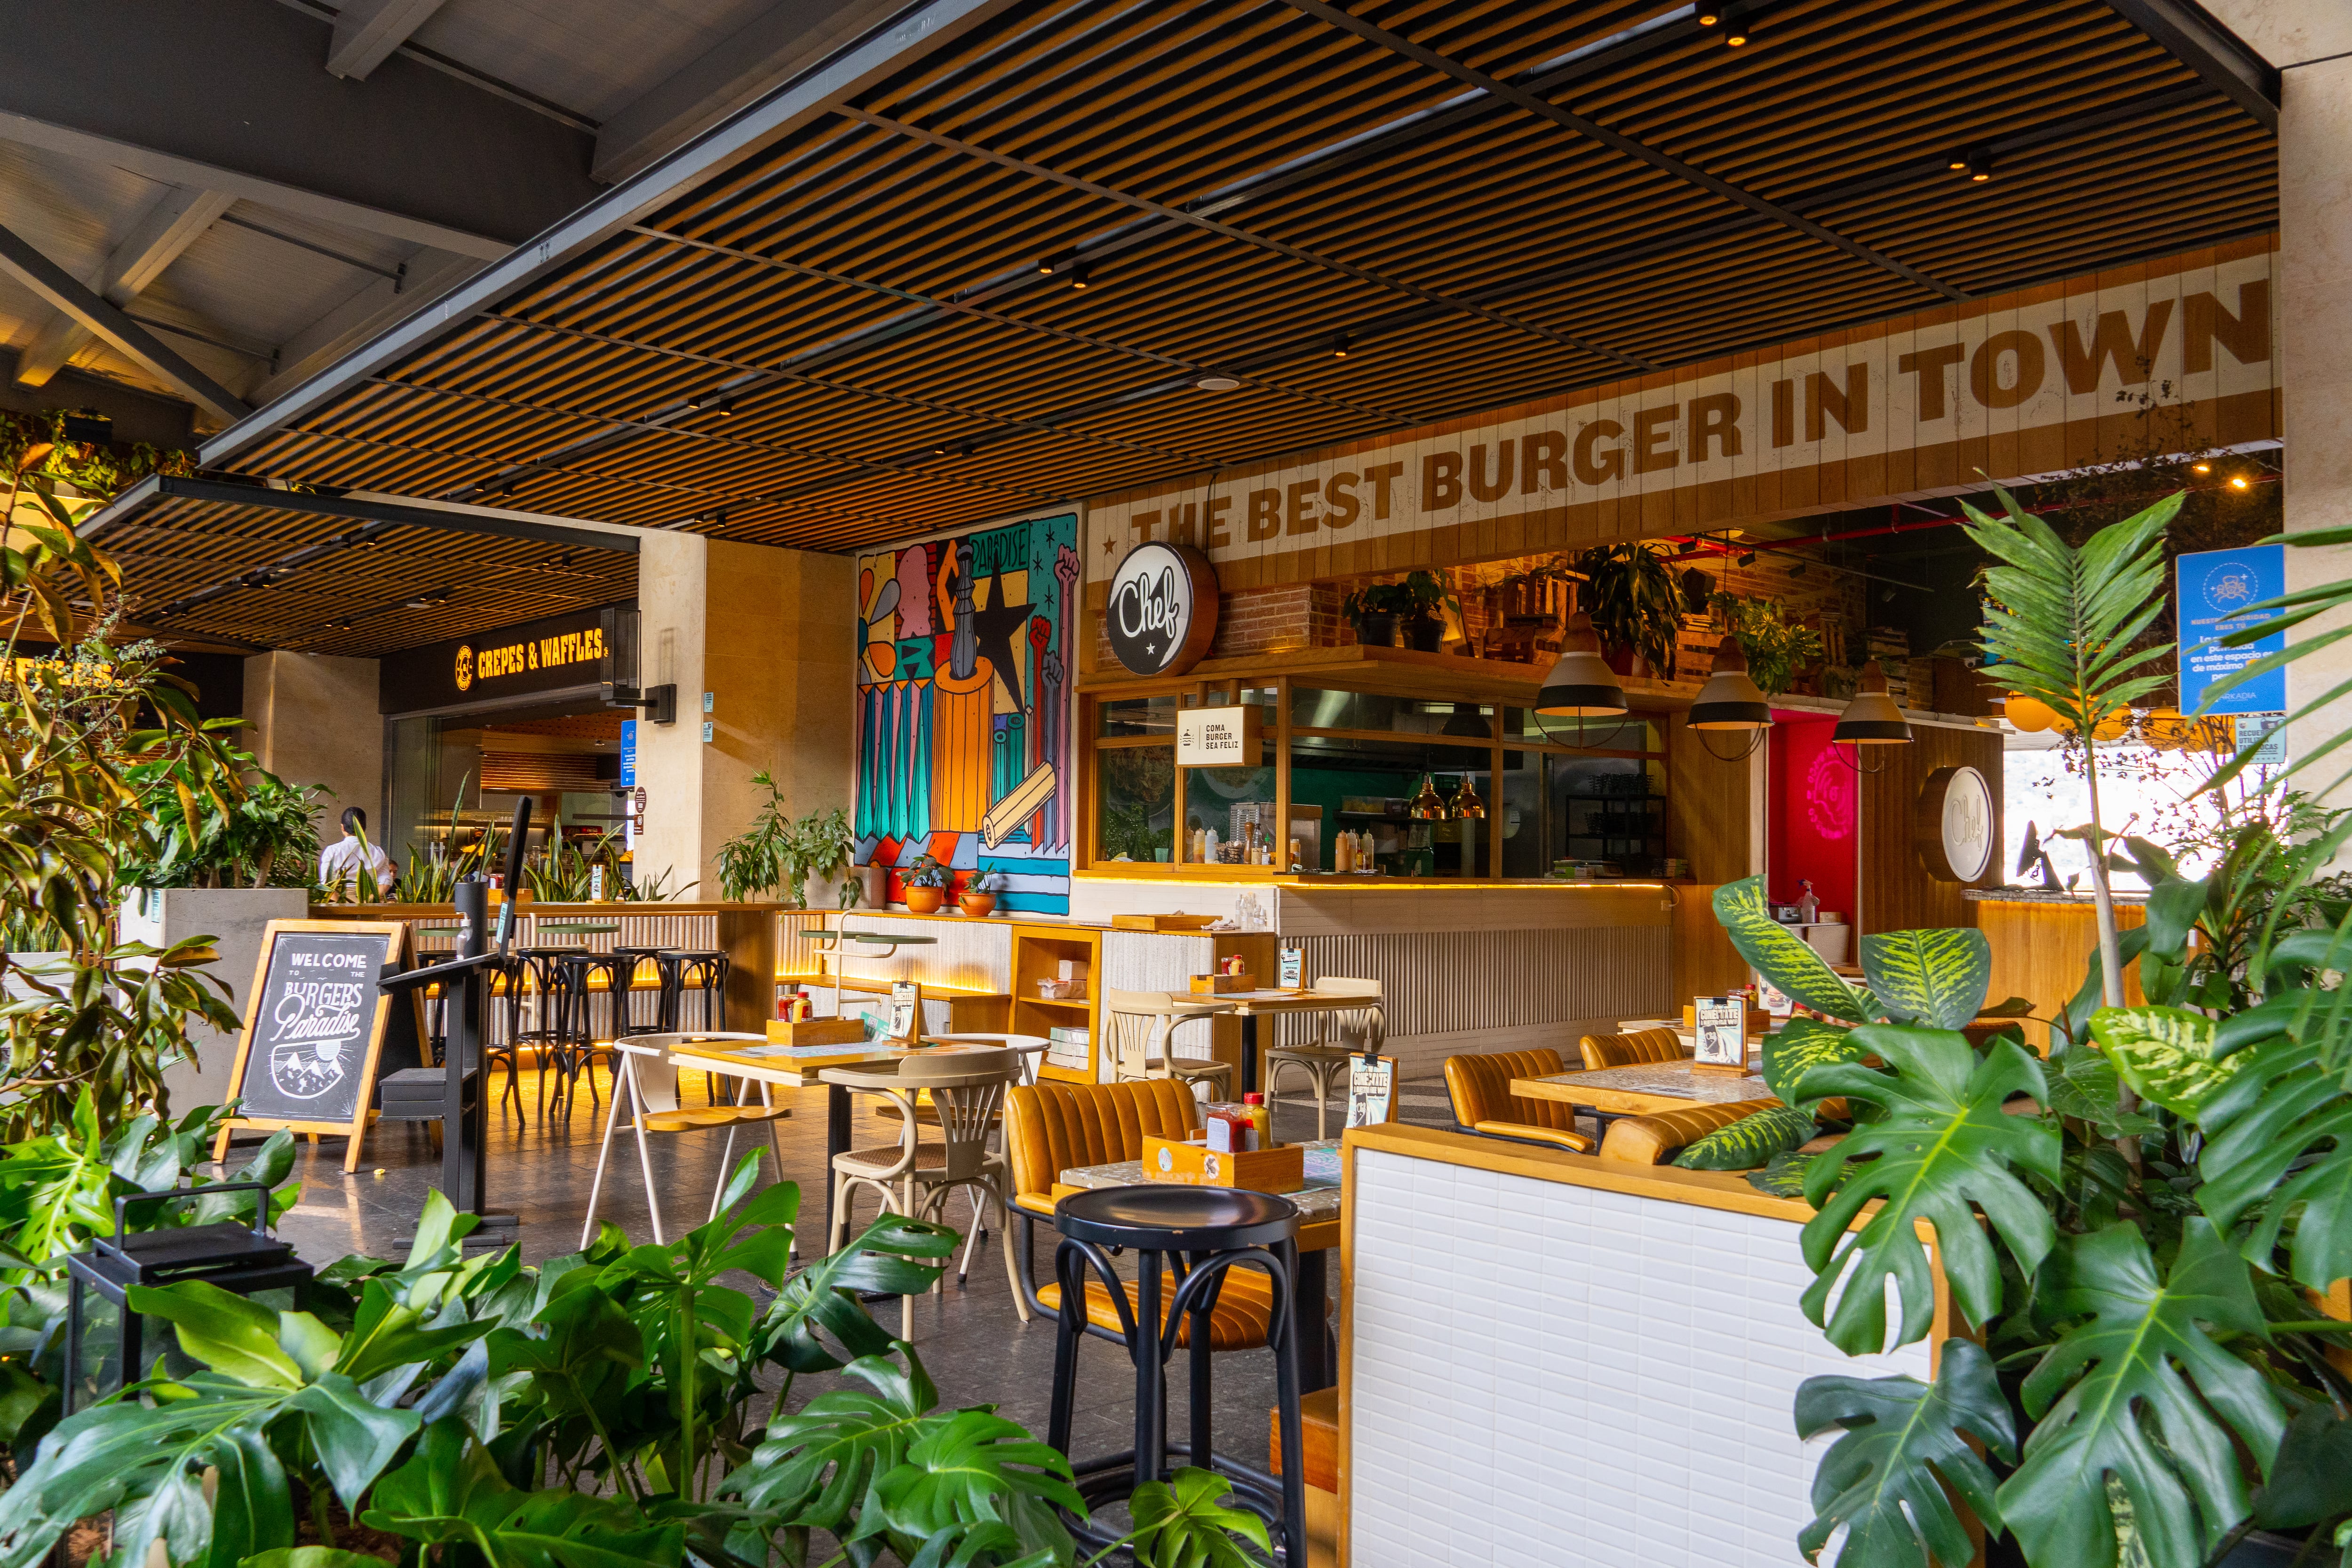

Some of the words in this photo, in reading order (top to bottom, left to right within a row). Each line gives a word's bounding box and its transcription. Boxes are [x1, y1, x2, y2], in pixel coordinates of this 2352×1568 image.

[1131, 496, 1232, 550] THE
[1248, 461, 1404, 542] BEST
[1421, 392, 1743, 512] BURGER
[1772, 362, 1868, 448] IN
[1898, 278, 2271, 422] TOWN
[971, 528, 1026, 572] PARADISE
[1119, 567, 1178, 639] Chef
[478, 644, 524, 679] CREPES
[528, 642, 539, 669] &
[540, 628, 603, 668] WAFFLES
[2225, 651, 2262, 661] espacio
[2192, 664, 2205, 672] de
[2206, 662, 2244, 671] máximo
[1206, 724, 1225, 732] COMA
[1206, 732, 1232, 741] BURGER
[1220, 740, 1239, 749] FELIZ
[291, 953, 367, 968] WELCOME
[284, 981, 364, 1008] BURGERS
[270, 993, 361, 1042] Paradise
